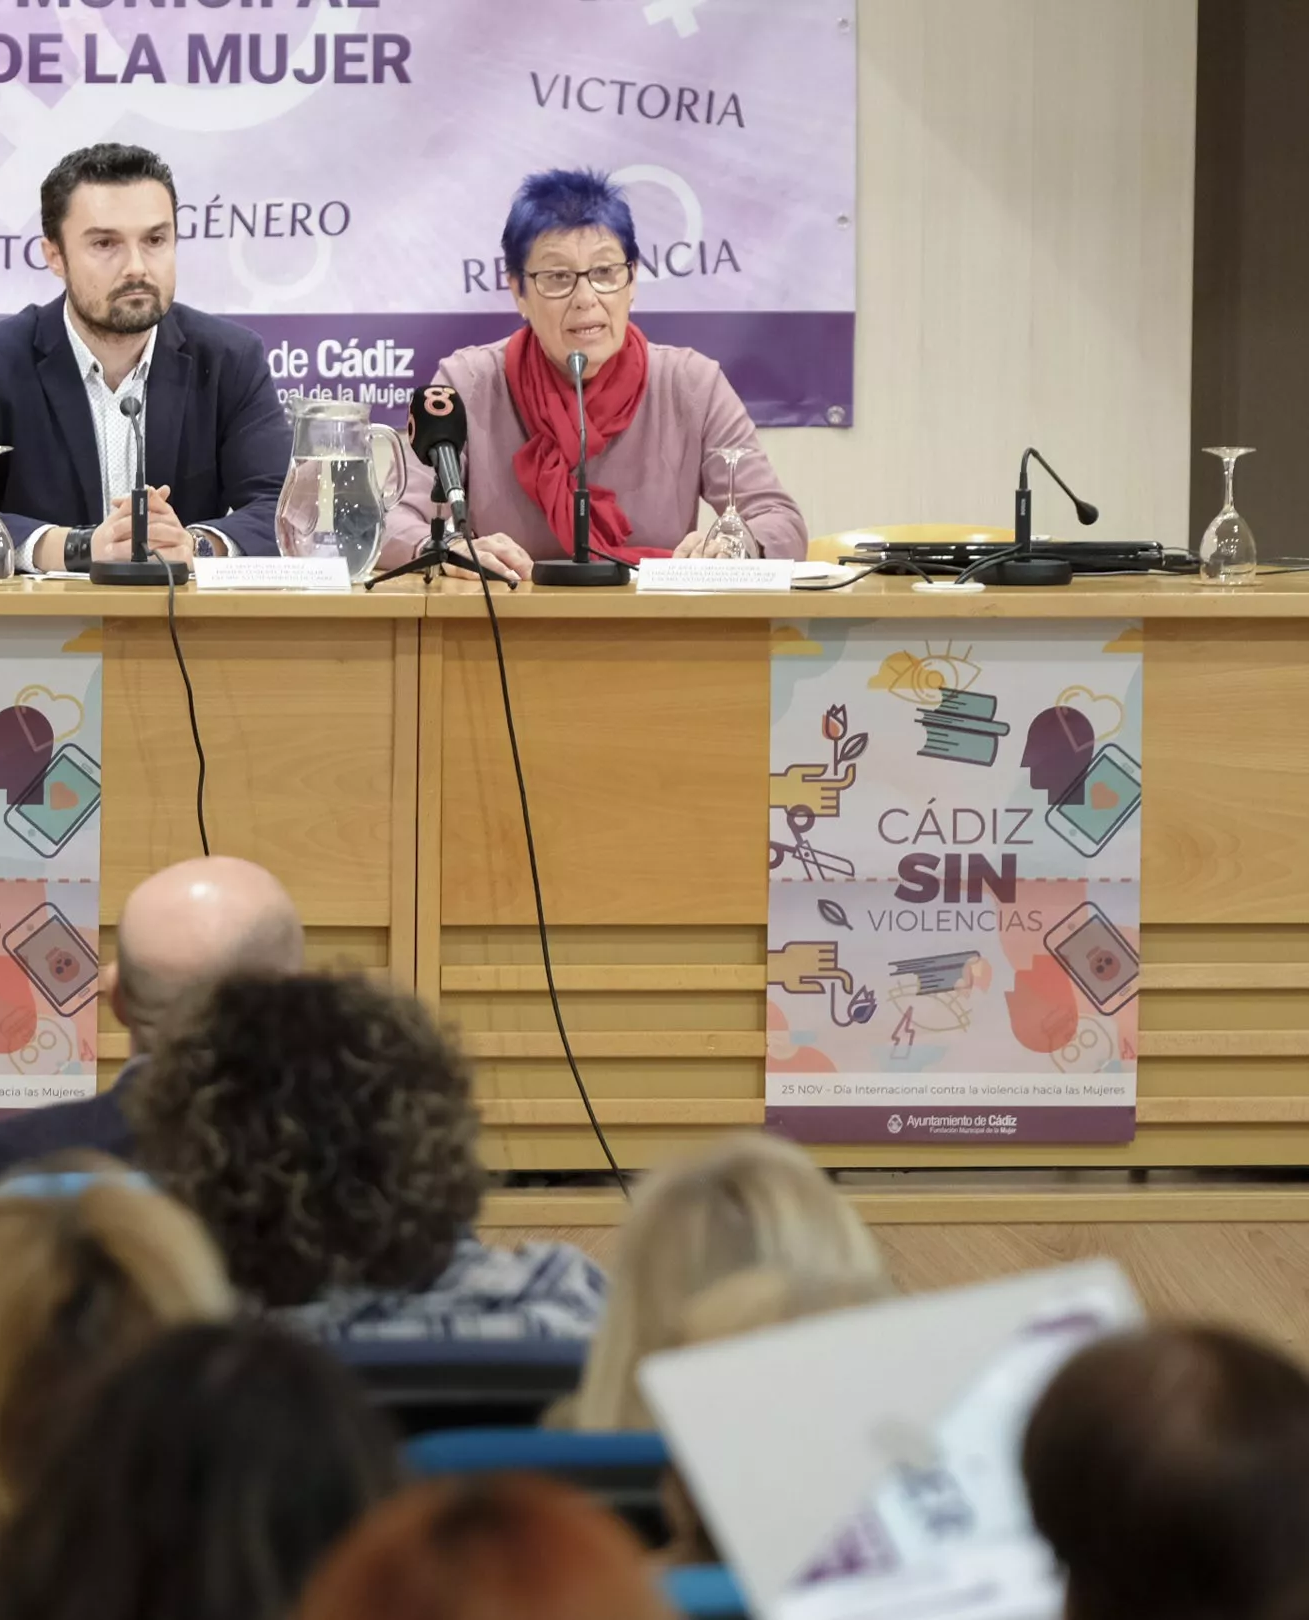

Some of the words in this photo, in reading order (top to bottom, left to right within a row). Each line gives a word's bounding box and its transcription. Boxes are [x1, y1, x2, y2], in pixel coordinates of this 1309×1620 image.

[84, 33, 167, 84] LA
[187, 33, 412, 84] MUJER
[530, 71, 745, 128] VICTORIA
[176, 194, 351, 240] GÉNERO
[267, 340, 309, 378] de
[317, 338, 415, 378] Cádiz
[309, 383, 333, 401] de
[337, 383, 354, 403] la
[359, 383, 415, 408] Mujer
[878, 797, 1034, 845] CÁDIZ
[894, 852, 1017, 903] SIN
[867, 909, 1043, 932] VIOLENCIAS
[24, 1087, 39, 1097] las
[42, 1087, 85, 1098] Mujeres
[781, 1085, 795, 1095] 25
[798, 1085, 823, 1095] NOV
[834, 1085, 852, 1095] Día
[855, 1084, 927, 1095] Internacional
[930, 1086, 966, 1095] contra
[969, 1085, 978, 1095] la
[982, 1085, 1030, 1095] violencia
[1033, 1085, 1062, 1095] hacia
[1065, 1085, 1080, 1095] las
[1083, 1085, 1125, 1097] Mujeres
[907, 1115, 972, 1128] Ayuntamiento
[974, 1115, 986, 1126] de
[988, 1114, 1017, 1126] Cádiz
